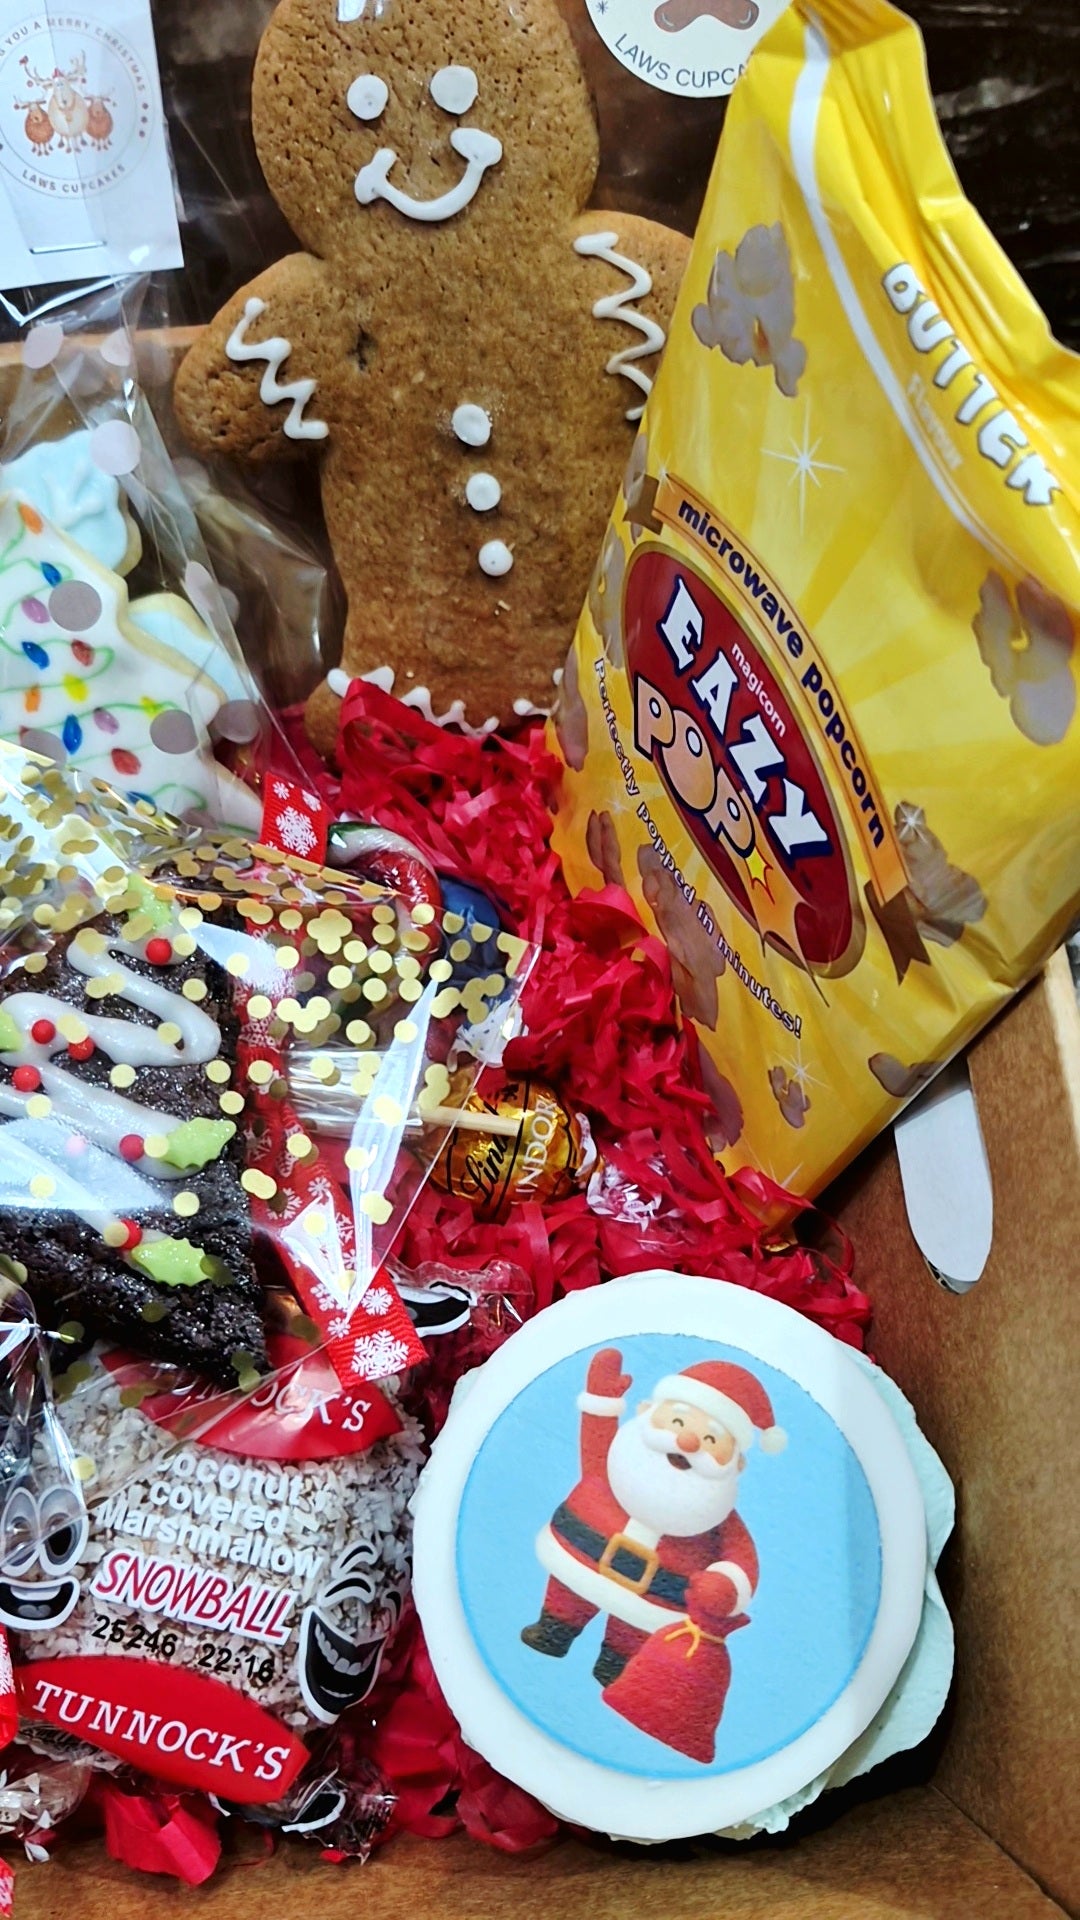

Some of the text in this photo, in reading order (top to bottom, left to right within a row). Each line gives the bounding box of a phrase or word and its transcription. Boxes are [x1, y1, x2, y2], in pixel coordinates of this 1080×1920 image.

[5, 26, 28, 45] YOU
[34, 21, 41, 30] A
[47, 18, 90, 29] MERRY
[614, 33, 671, 81] LAWS
[22, 163, 125, 193] LAWS CUPCAKES
[660, 577, 831, 860] EAZY
[678, 499, 885, 850] microwave popcorn
[731, 642, 786, 738] magicorn
[634, 673, 756, 858] POP
[595, 657, 802, 1040] Perfectly popped in minutes!
[96, 1494, 325, 1579] Marshmallow
[150, 1481, 290, 1537] covered
[91, 1550, 292, 1643] SNOWBALL
[198, 1643, 274, 1683] 22:16
[32, 1680, 291, 1781] TUNNOCK'S
